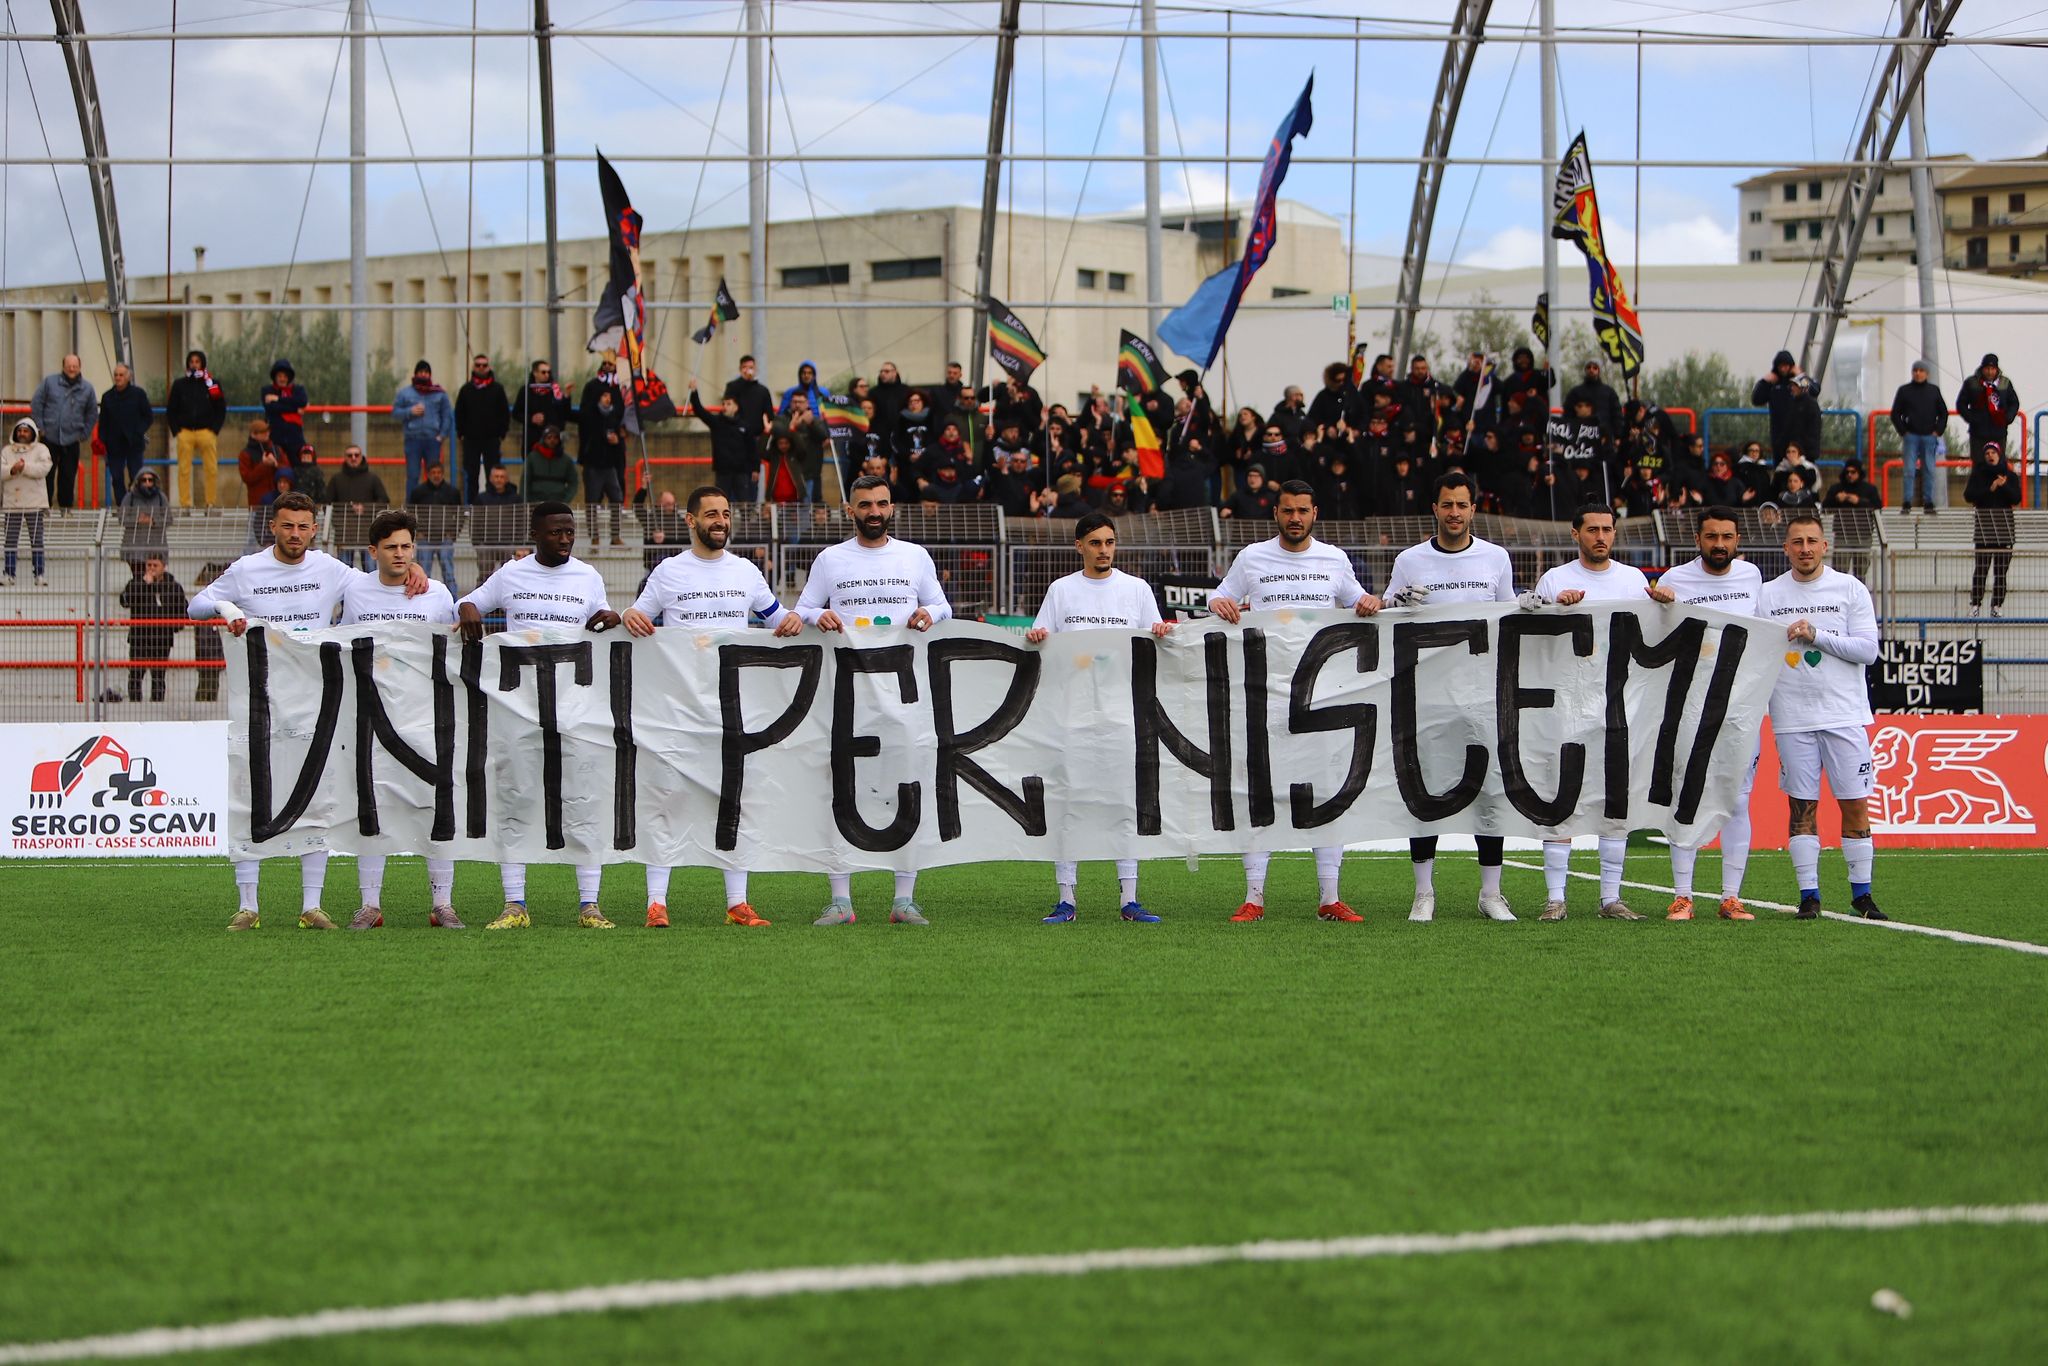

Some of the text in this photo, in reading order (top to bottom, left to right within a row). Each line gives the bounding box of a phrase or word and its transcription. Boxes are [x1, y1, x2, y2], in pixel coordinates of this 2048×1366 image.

[1561, 442, 1594, 460] oda
[1260, 574, 1285, 584] NISCEMI
[1301, 573, 1308, 581] SI
[836, 578, 911, 590] NISCEMI NON SI FERMA!
[1446, 582, 1460, 590] NON
[1460, 581, 1467, 589] SI
[253, 586, 279, 595] NISCEMI
[280, 585, 293, 593] NON
[294, 584, 301, 592] SI
[512, 592, 537, 600] NISCEMI
[538, 593, 553, 601] NON
[554, 594, 561, 602] SI
[677, 591, 703, 602] NISCEMI
[704, 591, 718, 599] NON
[719, 590, 726, 598] SI
[854, 597, 867, 606] PER
[867, 596, 877, 605] LA
[1262, 594, 1276, 603] UNITI
[1277, 593, 1290, 601] PER
[1291, 593, 1300, 601] LA
[1708, 594, 1722, 602] NON
[1722, 593, 1729, 601] SI
[1770, 606, 1795, 616] NISCEMI
[1795, 606, 1809, 614] NON
[1817, 605, 1840, 613] FERMA!
[270, 615, 283, 623] PER
[284, 614, 293, 622] LA
[381, 613, 395, 621] NON
[526, 612, 539, 621] PER
[540, 613, 548, 621] LA
[680, 612, 695, 621] UNITI
[695, 611, 708, 620] PER
[708, 611, 717, 619] LA
[1087, 616, 1100, 624] NON
[1100, 616, 1107, 624] SI
[1883, 663, 1958, 685] LIBERI
[1906, 684, 1931, 705] DI
[248, 611, 1748, 852] UNITI PER NISCEMI
[170, 797, 200, 806] S.R.L.S.
[11, 812, 216, 836] SERGIO SCAVI
[12, 837, 85, 849] TRASPORTI
[95, 836, 136, 849] CASSE
[140, 836, 216, 848] SCARRABILI
